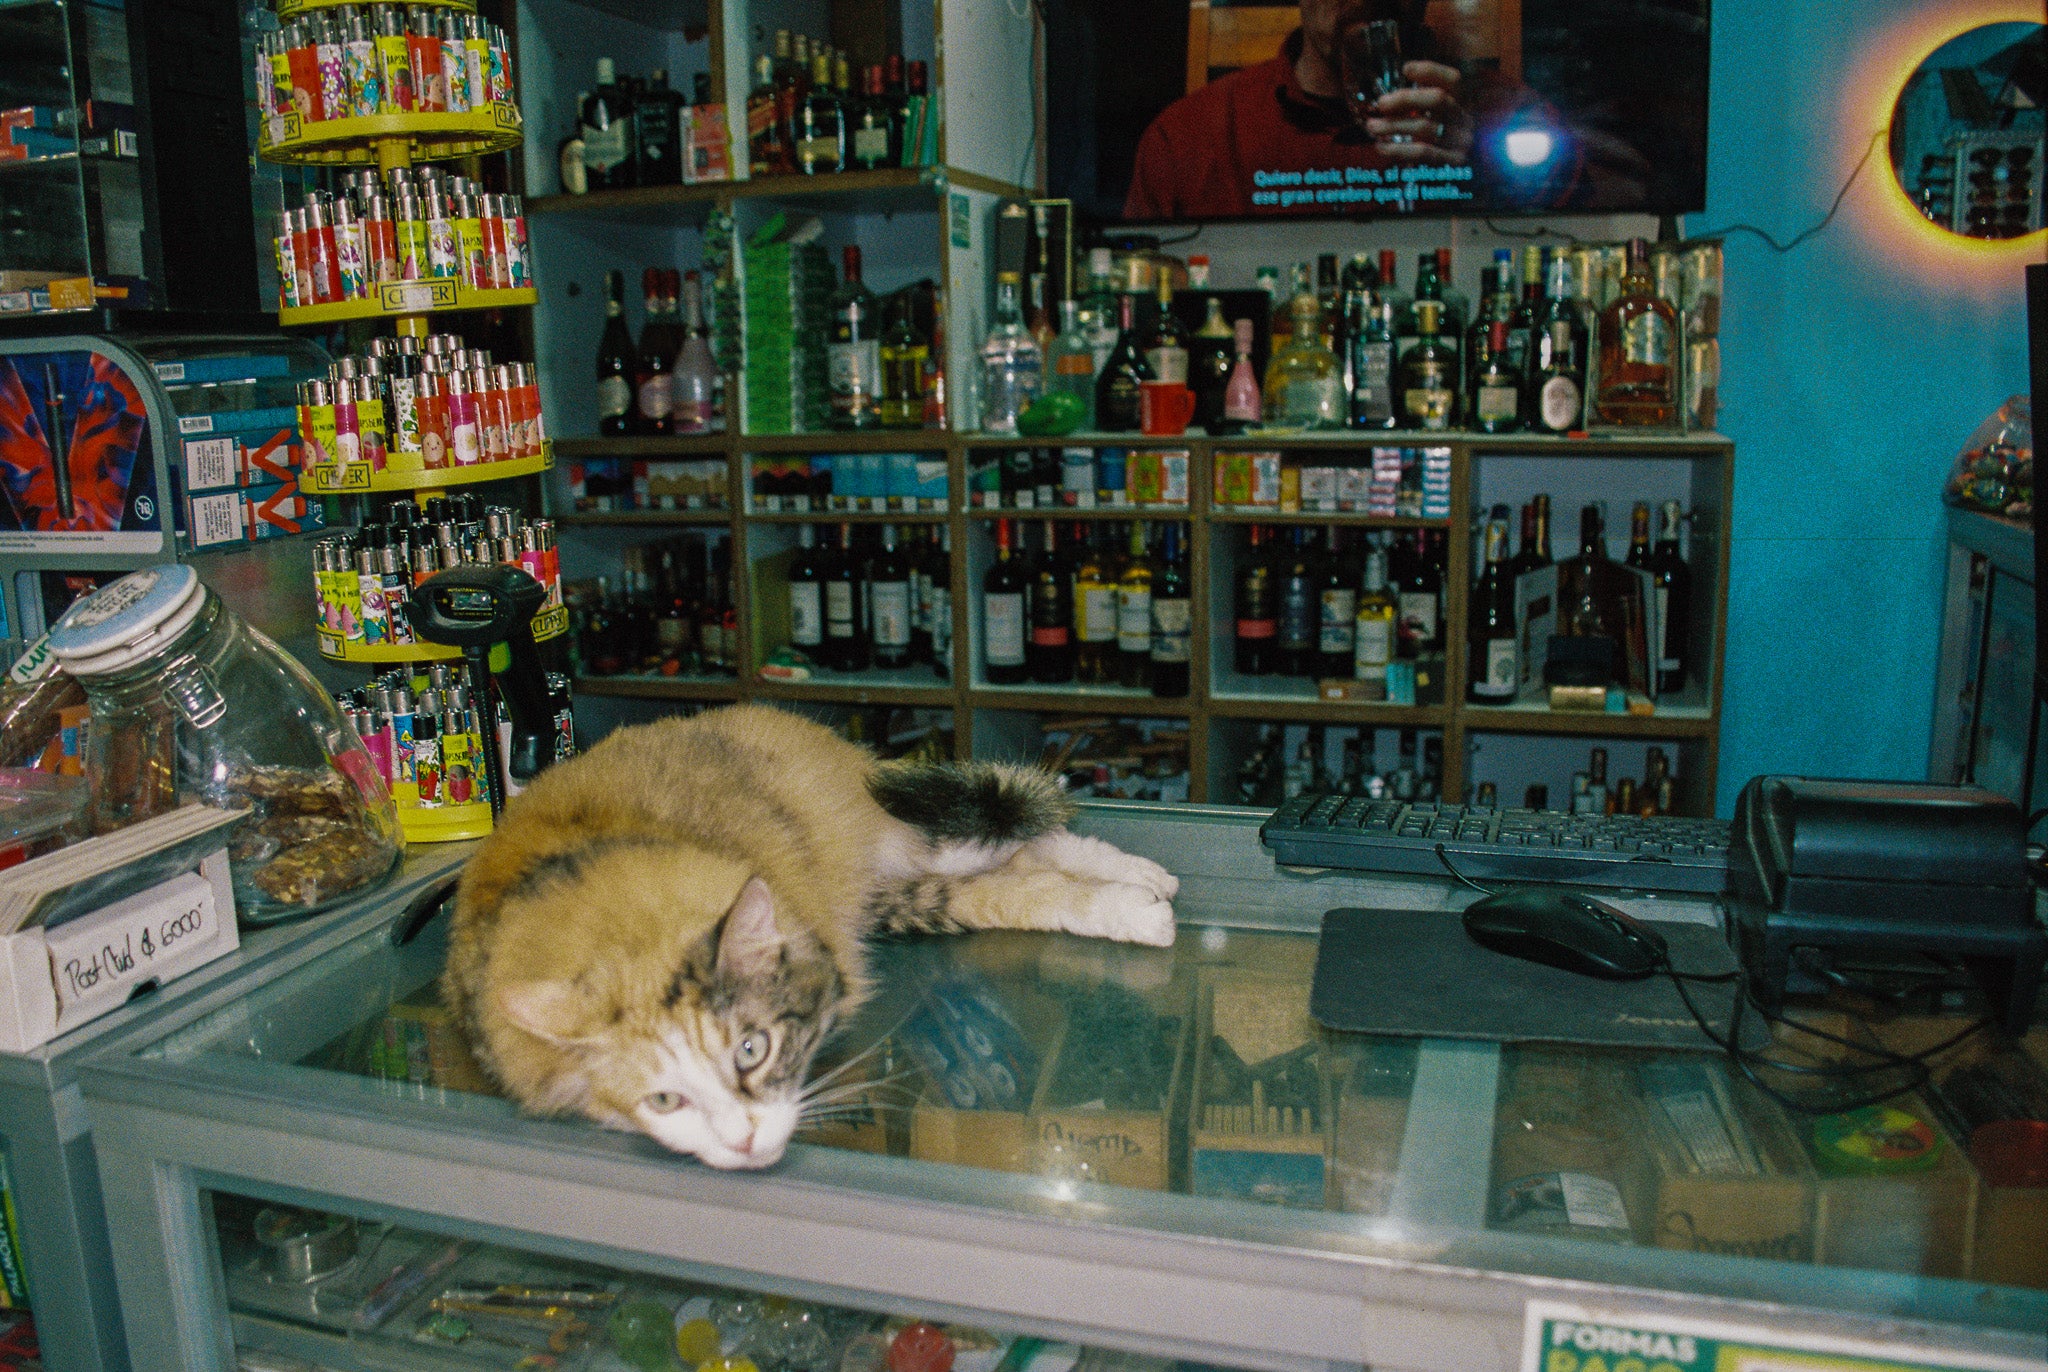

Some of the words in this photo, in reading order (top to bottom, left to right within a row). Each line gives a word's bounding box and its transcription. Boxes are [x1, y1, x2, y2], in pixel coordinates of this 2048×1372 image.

[1254, 170, 1302, 187] Quiero
[1345, 167, 1382, 184] Dios,
[1252, 191, 1279, 205] ese
[1281, 189, 1314, 207] gran
[1316, 186, 1372, 203] cerebro
[1374, 188, 1402, 205] que
[65, 955, 102, 998] Post
[1552, 1322, 1698, 1364] FORMAS
